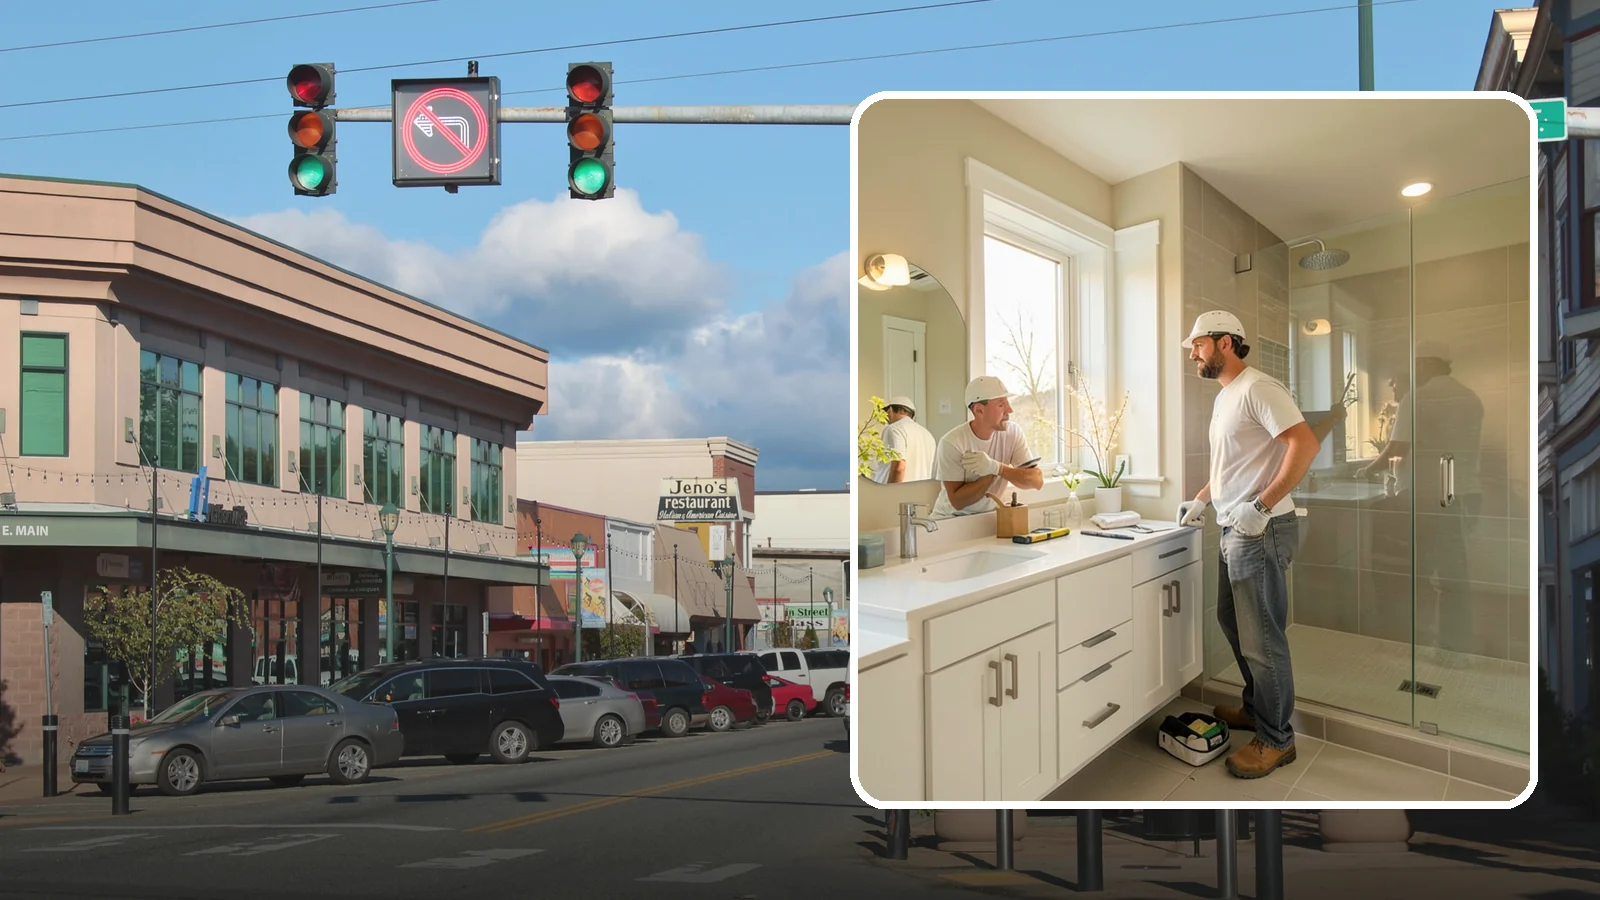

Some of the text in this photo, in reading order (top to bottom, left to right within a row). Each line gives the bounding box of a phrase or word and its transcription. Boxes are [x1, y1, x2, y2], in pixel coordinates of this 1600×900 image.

[670, 480, 727, 494] Jeno's
[665, 496, 731, 509] restaurant
[658, 510, 681, 520] Italian
[686, 510, 714, 520] American
[715, 510, 737, 520] Cuisine
[2, 525, 49, 536] E. MAIN
[797, 607, 828, 617] Street
[790, 619, 824, 627] lass
